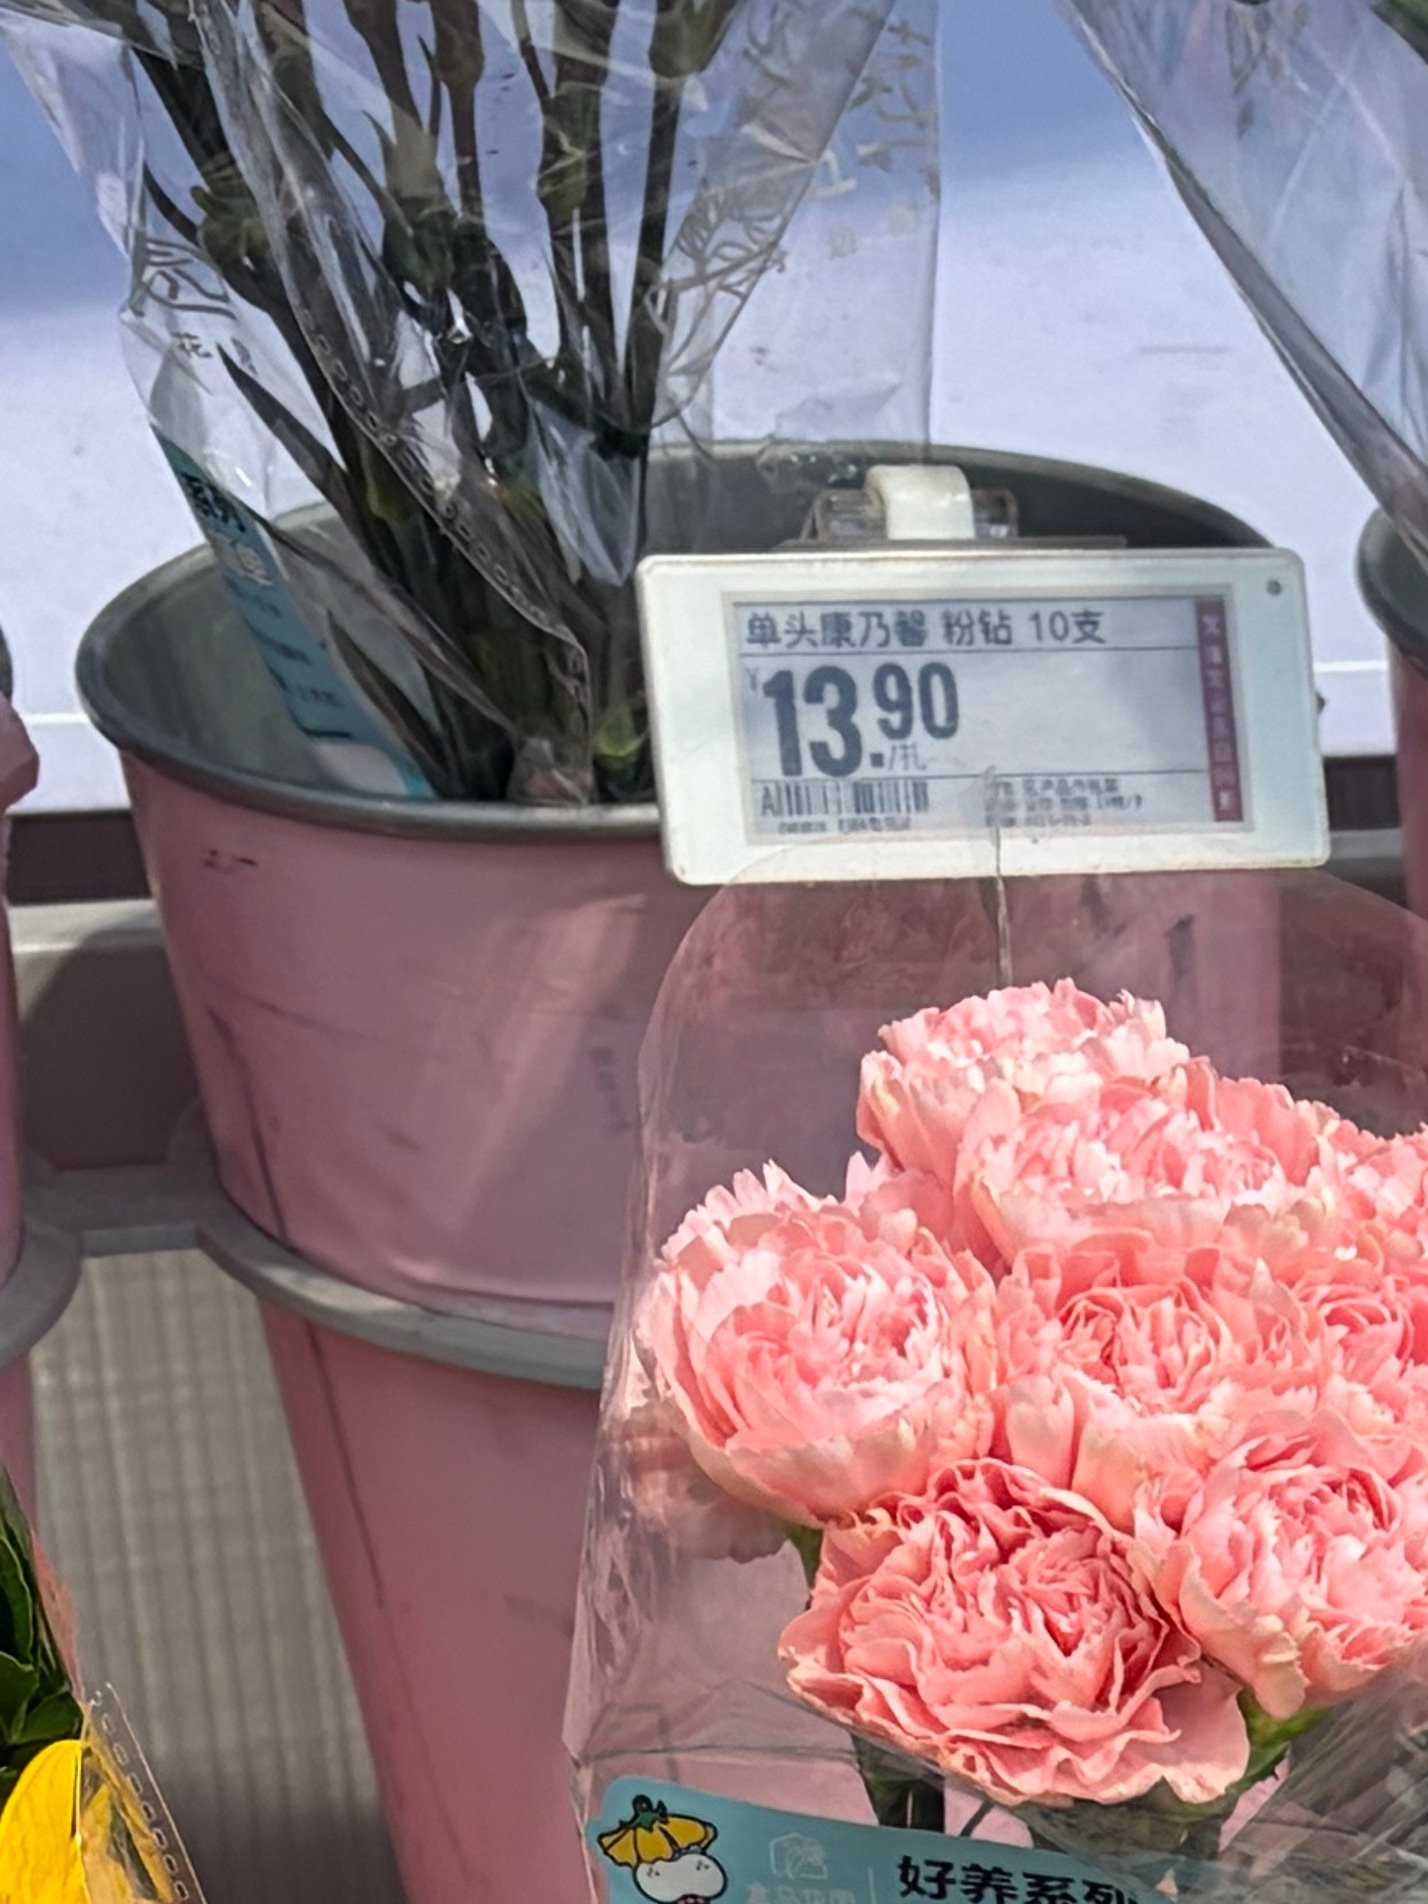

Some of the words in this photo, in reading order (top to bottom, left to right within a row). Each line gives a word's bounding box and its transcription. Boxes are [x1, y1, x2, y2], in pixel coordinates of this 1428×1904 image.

[744, 609, 929, 649] 单头康乃馨
[942, 608, 1014, 647] 粉钻
[1029, 608, 1106, 645] 10支
